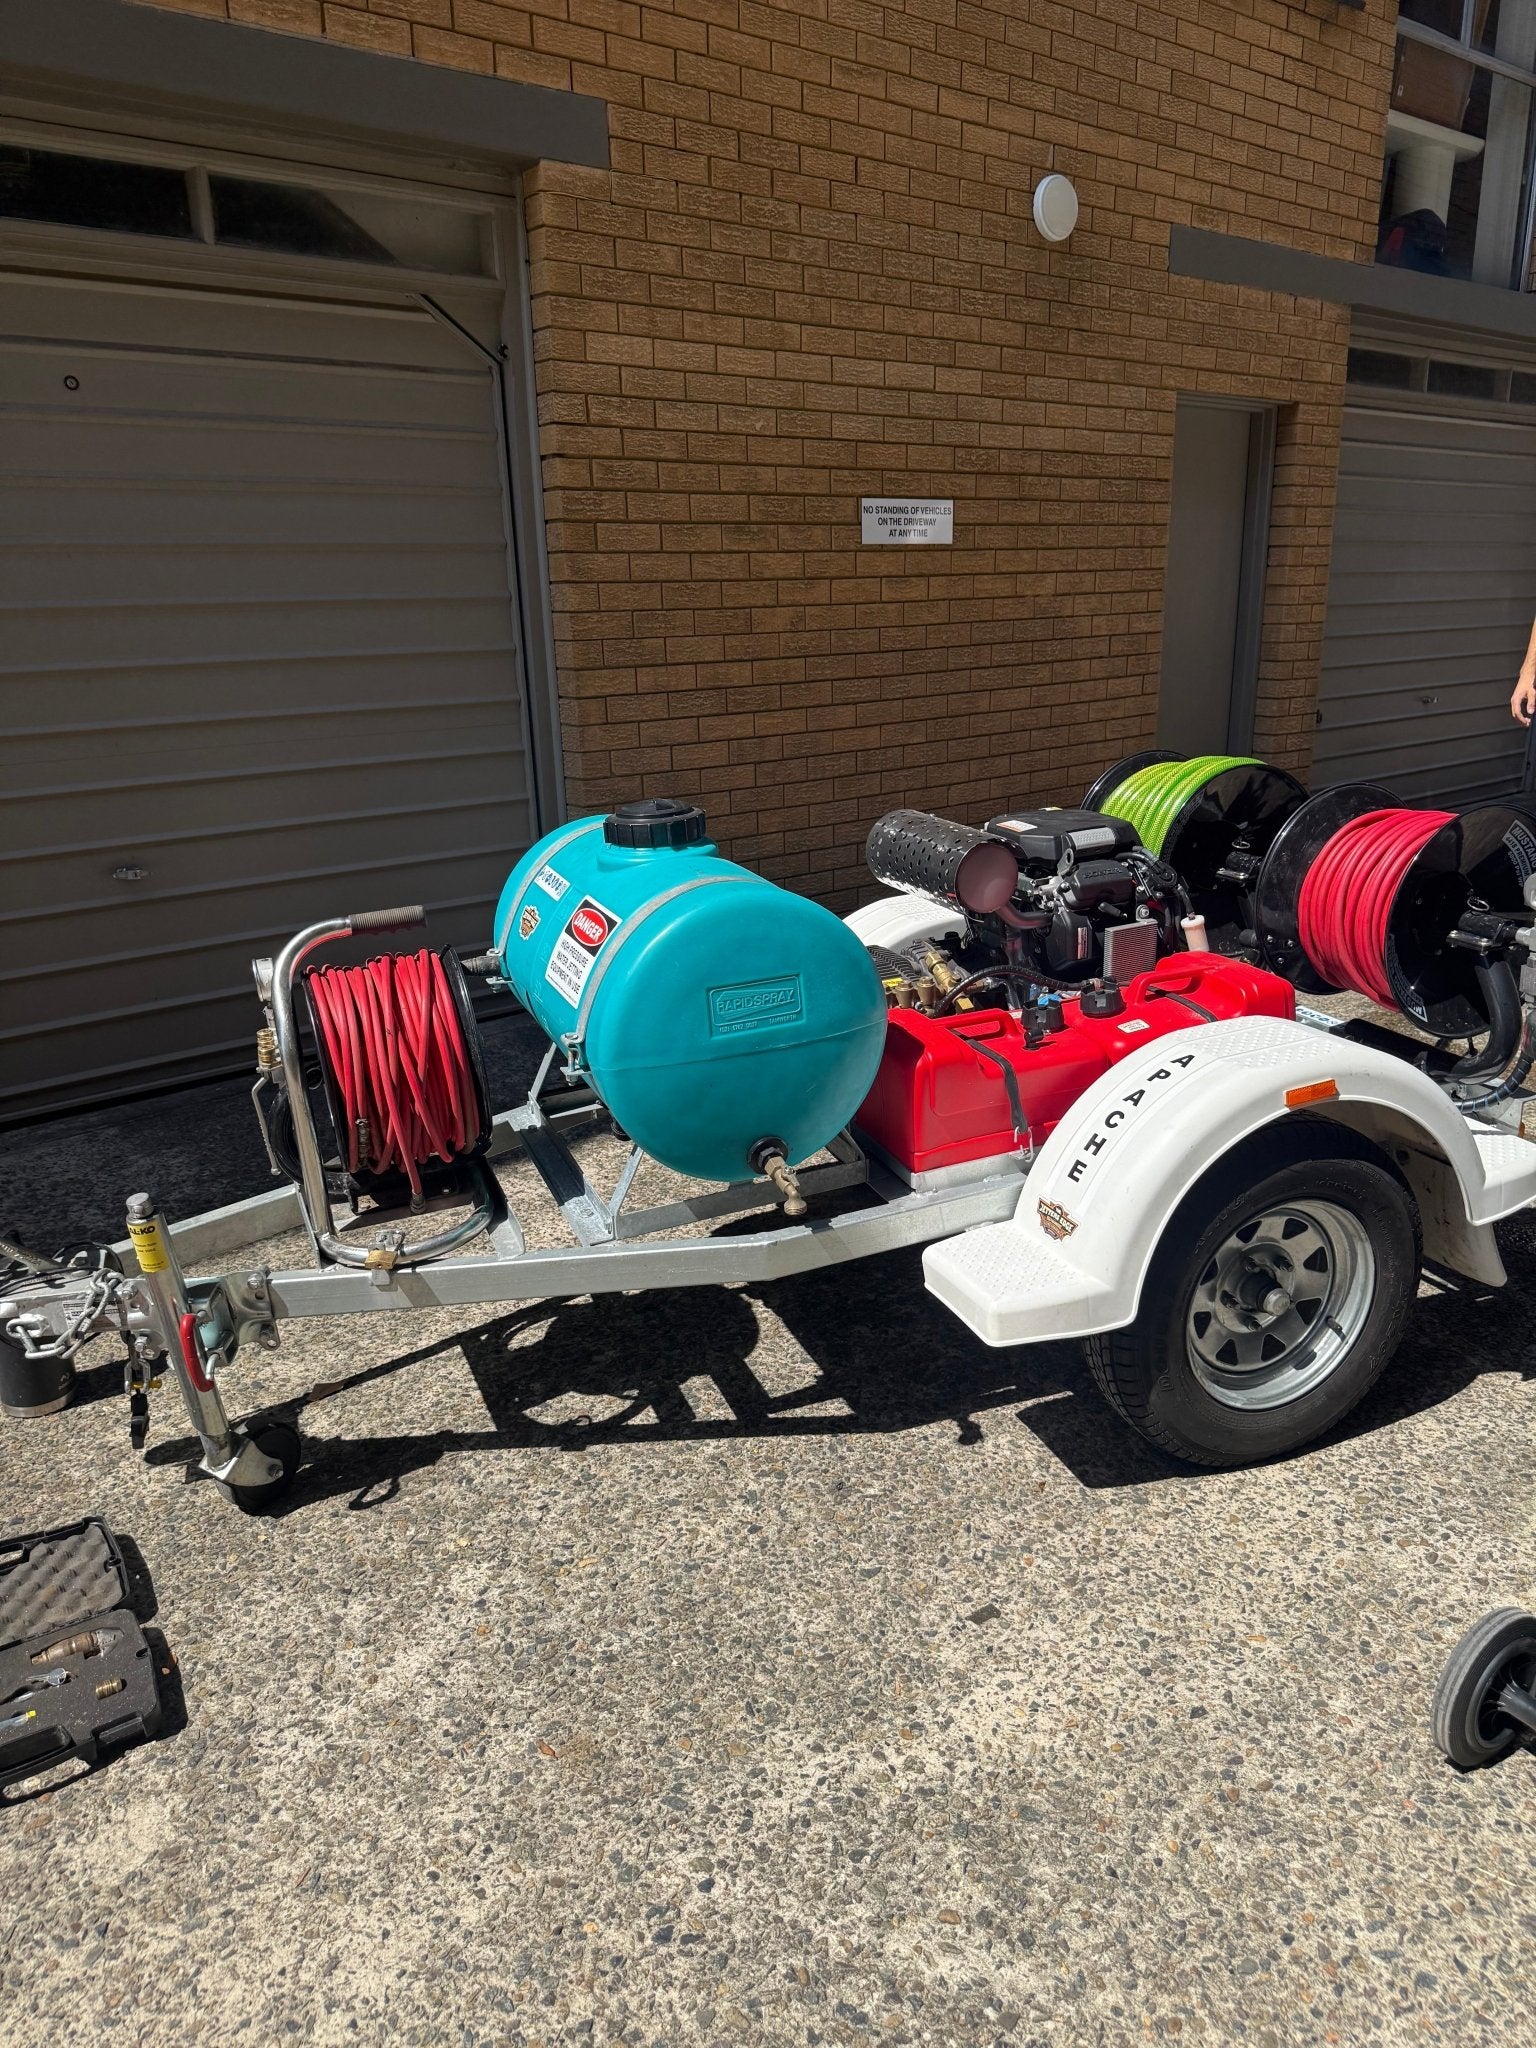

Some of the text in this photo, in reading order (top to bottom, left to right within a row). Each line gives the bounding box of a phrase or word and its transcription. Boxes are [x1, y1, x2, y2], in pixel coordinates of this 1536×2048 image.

[863, 506, 952, 516] NO STANDING OF VEHICLES
[877, 517, 937, 526] ON THE DRIVEWAY
[888, 529, 928, 538] AT ANY TIME
[573, 912, 604, 943] DANGER
[717, 989, 794, 1014] RAPIDSPRAY
[1067, 1054, 1195, 1183] APACHE
